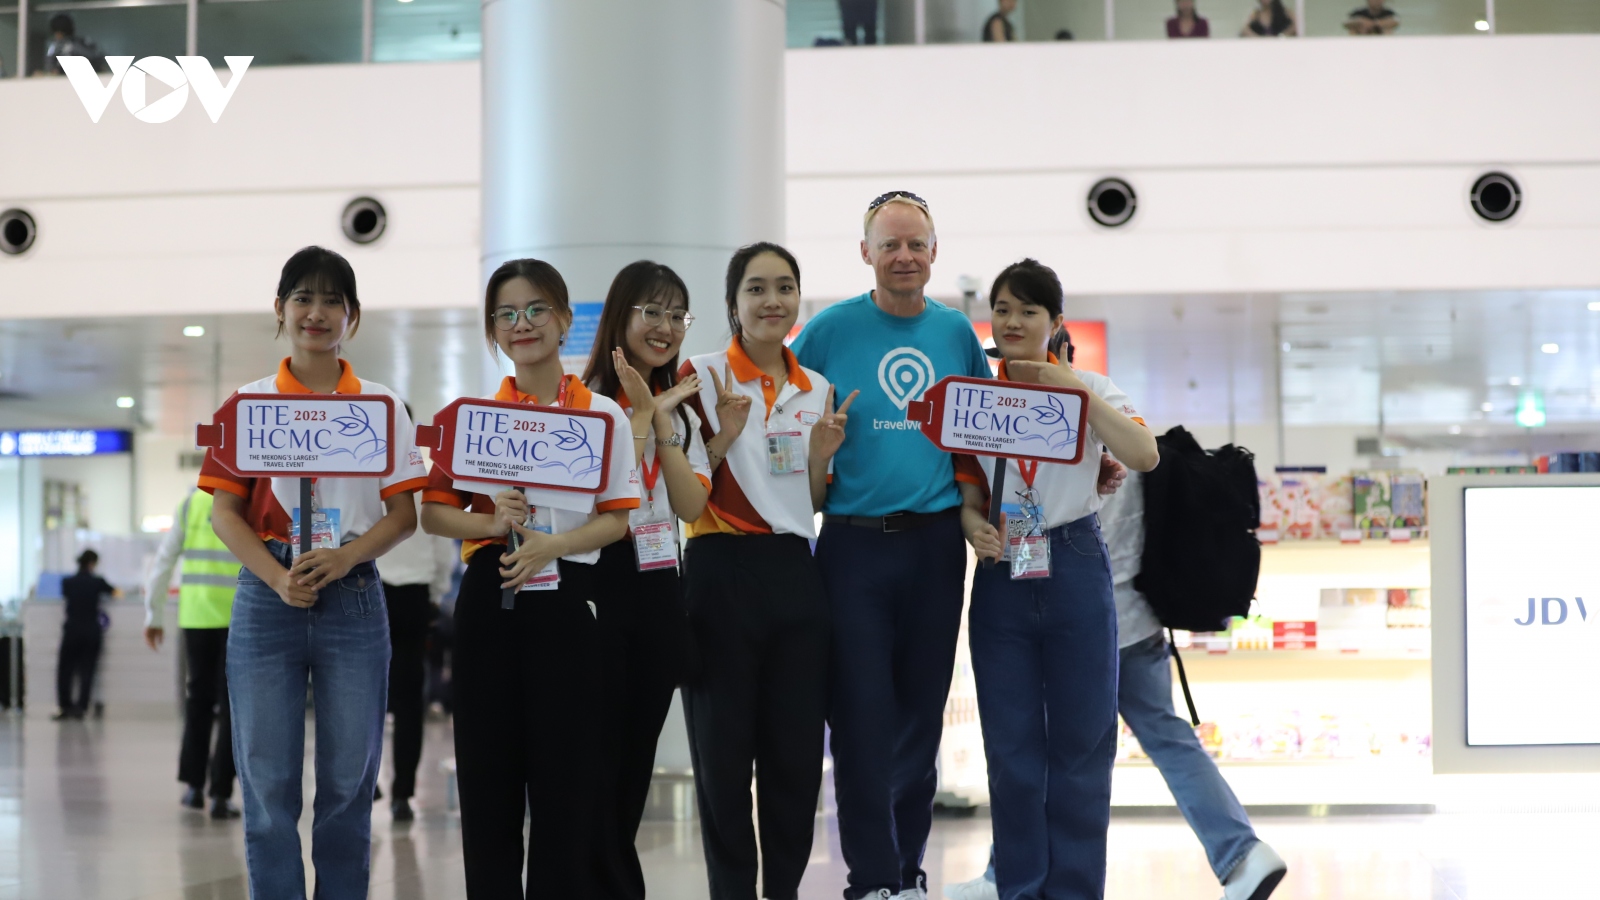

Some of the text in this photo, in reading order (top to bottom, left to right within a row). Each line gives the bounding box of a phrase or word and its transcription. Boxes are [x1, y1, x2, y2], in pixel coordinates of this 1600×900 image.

[955, 387, 1027, 409] ITE 2023
[247, 405, 327, 426] ITE 2023
[467, 410, 546, 434] ITE 2023
[953, 408, 1030, 435] HCMC
[247, 428, 332, 452] HCMC
[465, 433, 549, 463] HCMC
[963, 433, 992, 441] MEKONG'S
[985, 442, 1002, 450] EVENT
[477, 460, 507, 469] MEKONG'S
[508, 464, 534, 472] LARGEST
[478, 467, 499, 475] TRAVEL
[1514, 597, 1568, 626] JD
